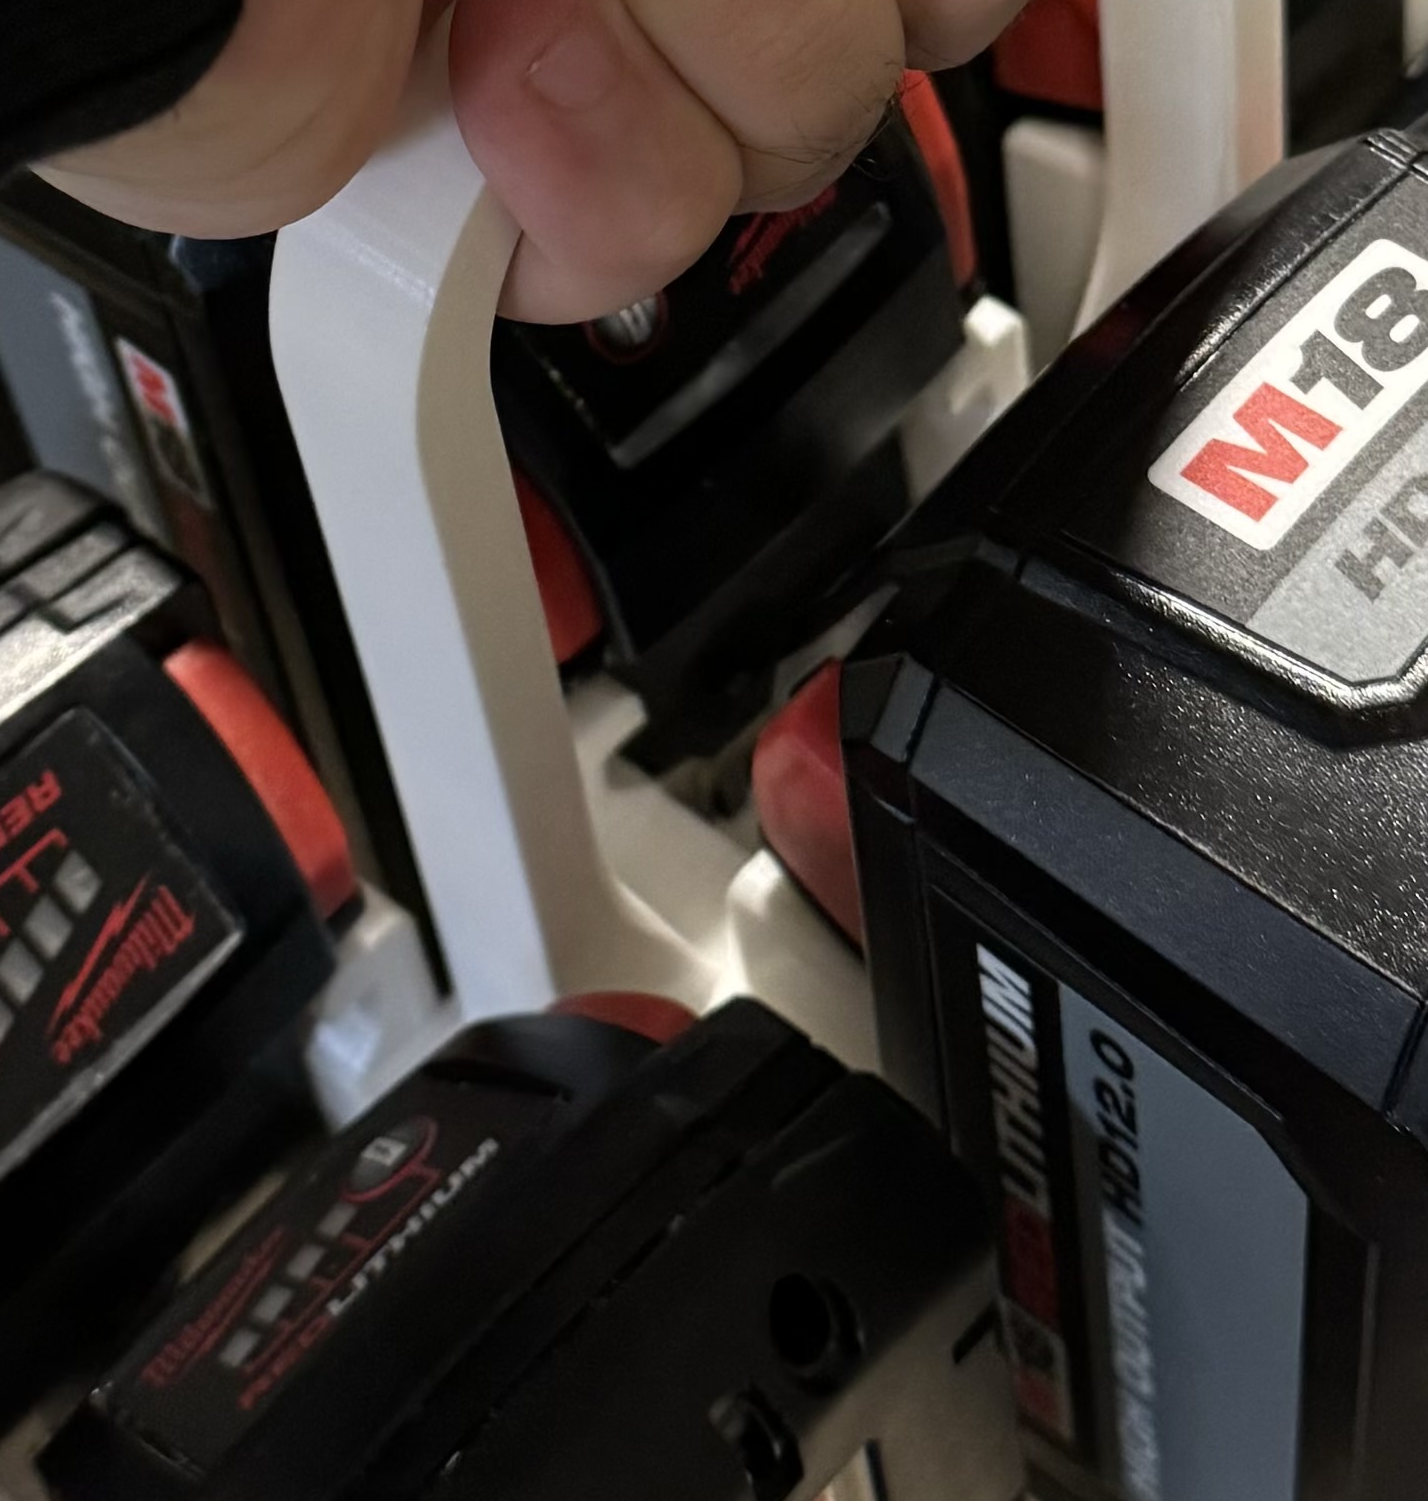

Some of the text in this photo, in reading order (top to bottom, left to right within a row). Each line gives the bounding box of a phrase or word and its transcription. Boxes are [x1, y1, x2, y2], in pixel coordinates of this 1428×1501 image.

[49, 884, 195, 1066] Milwaukee
[976, 943, 1059, 1327] LITHIUM
[1089, 1027, 1143, 1223] HD12.0
[238, 1136, 500, 1409] REDLITHIUM
[1100, 1209, 1153, 1395] OUTPUT
